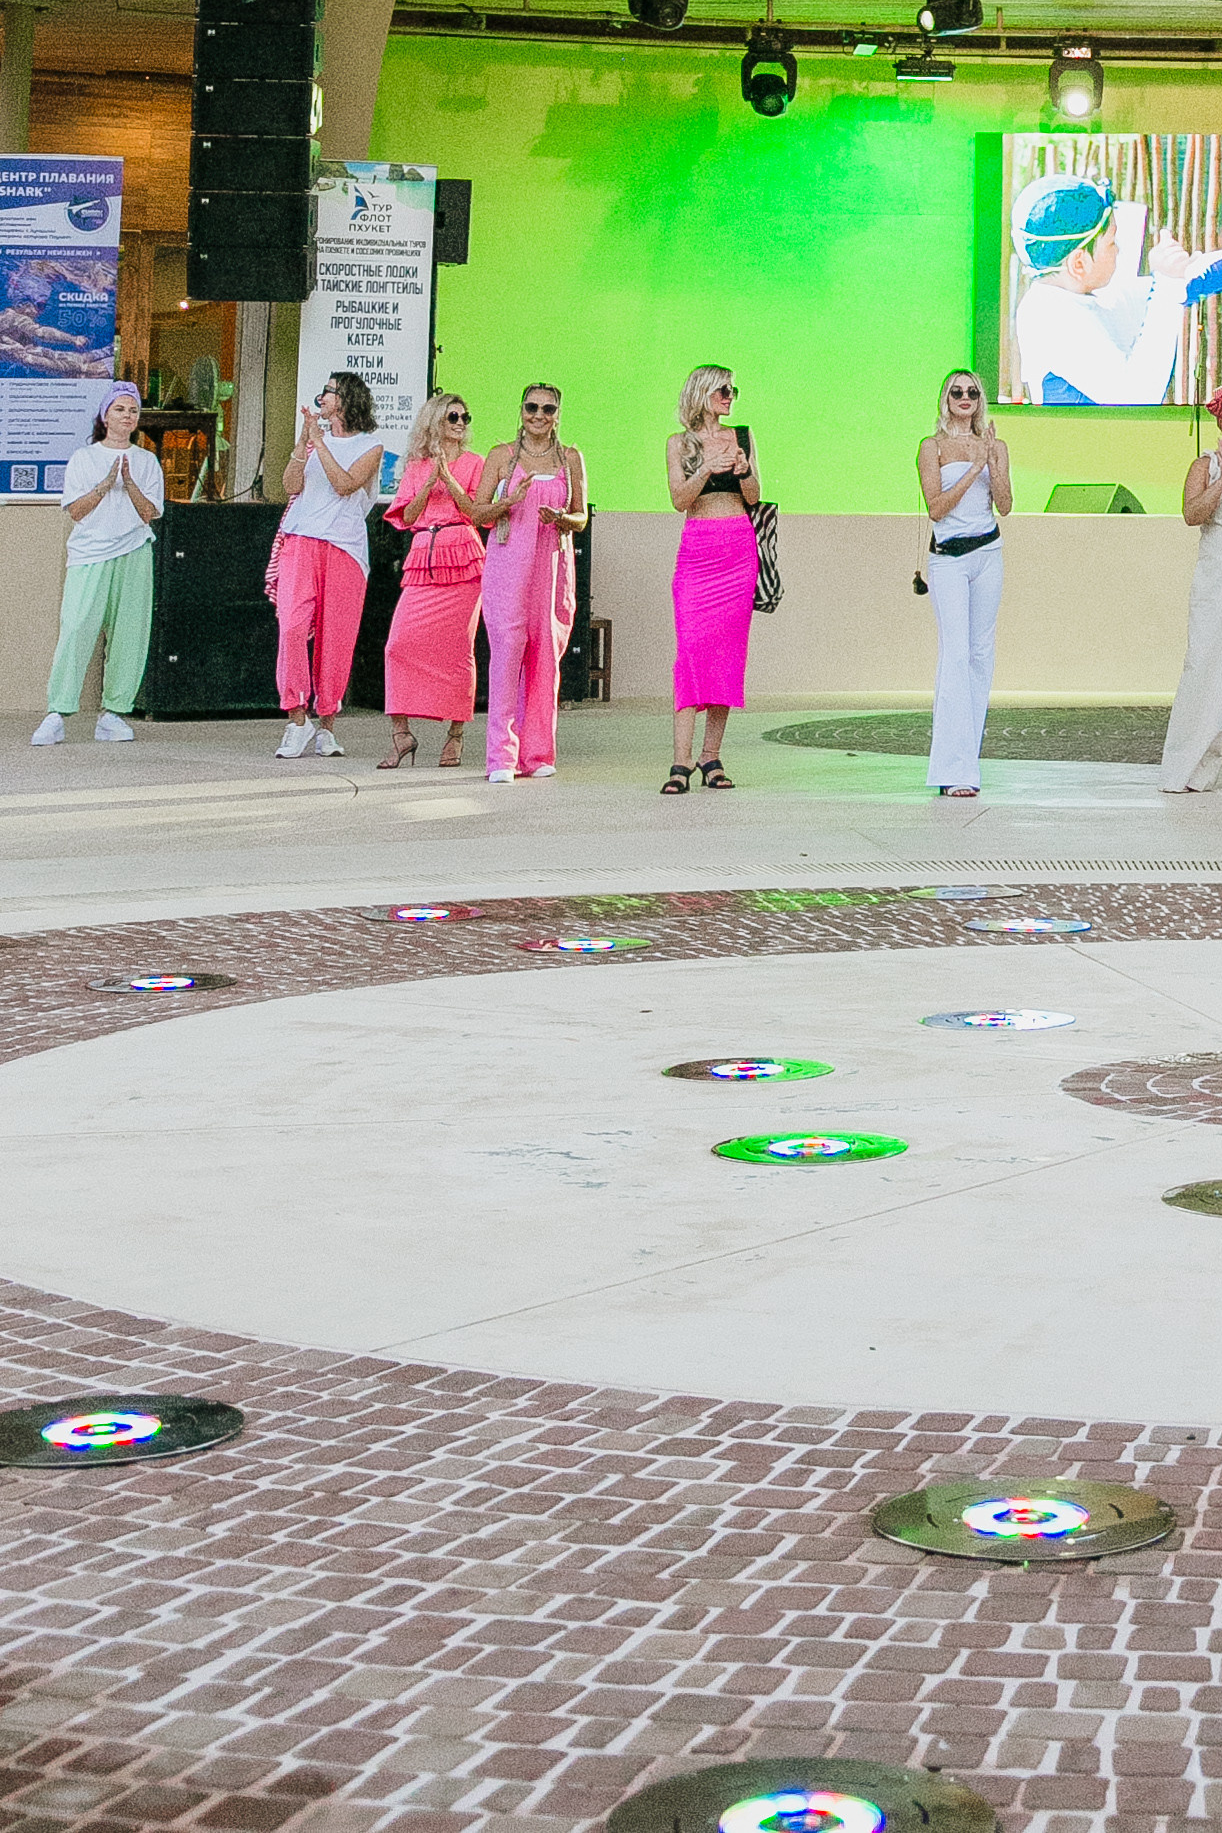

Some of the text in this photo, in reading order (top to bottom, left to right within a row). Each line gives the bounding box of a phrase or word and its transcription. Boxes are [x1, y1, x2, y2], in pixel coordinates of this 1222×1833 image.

[40, 172, 115, 184] ПЛАВАНИЯ
[372, 203, 393, 212] ТУР
[360, 214, 392, 223] ФЛОТ
[349, 224, 392, 233] ПХУКЕТ
[319, 263, 418, 278] СКОРОСТНЫЕ ЛОДКИ
[321, 277, 363, 293] ТАЙСКИЕ
[365, 279, 423, 294] ЛОНГТЕЙЛЫ
[59, 292, 109, 303] СКИДКА
[335, 300, 399, 314] РЫБАЦКИЕ И
[331, 316, 402, 330] ПРОГУЛОЧНЫЕ
[347, 333, 384, 346] КАТЕРА
[347, 355, 383, 368] ЯХТЫ И
